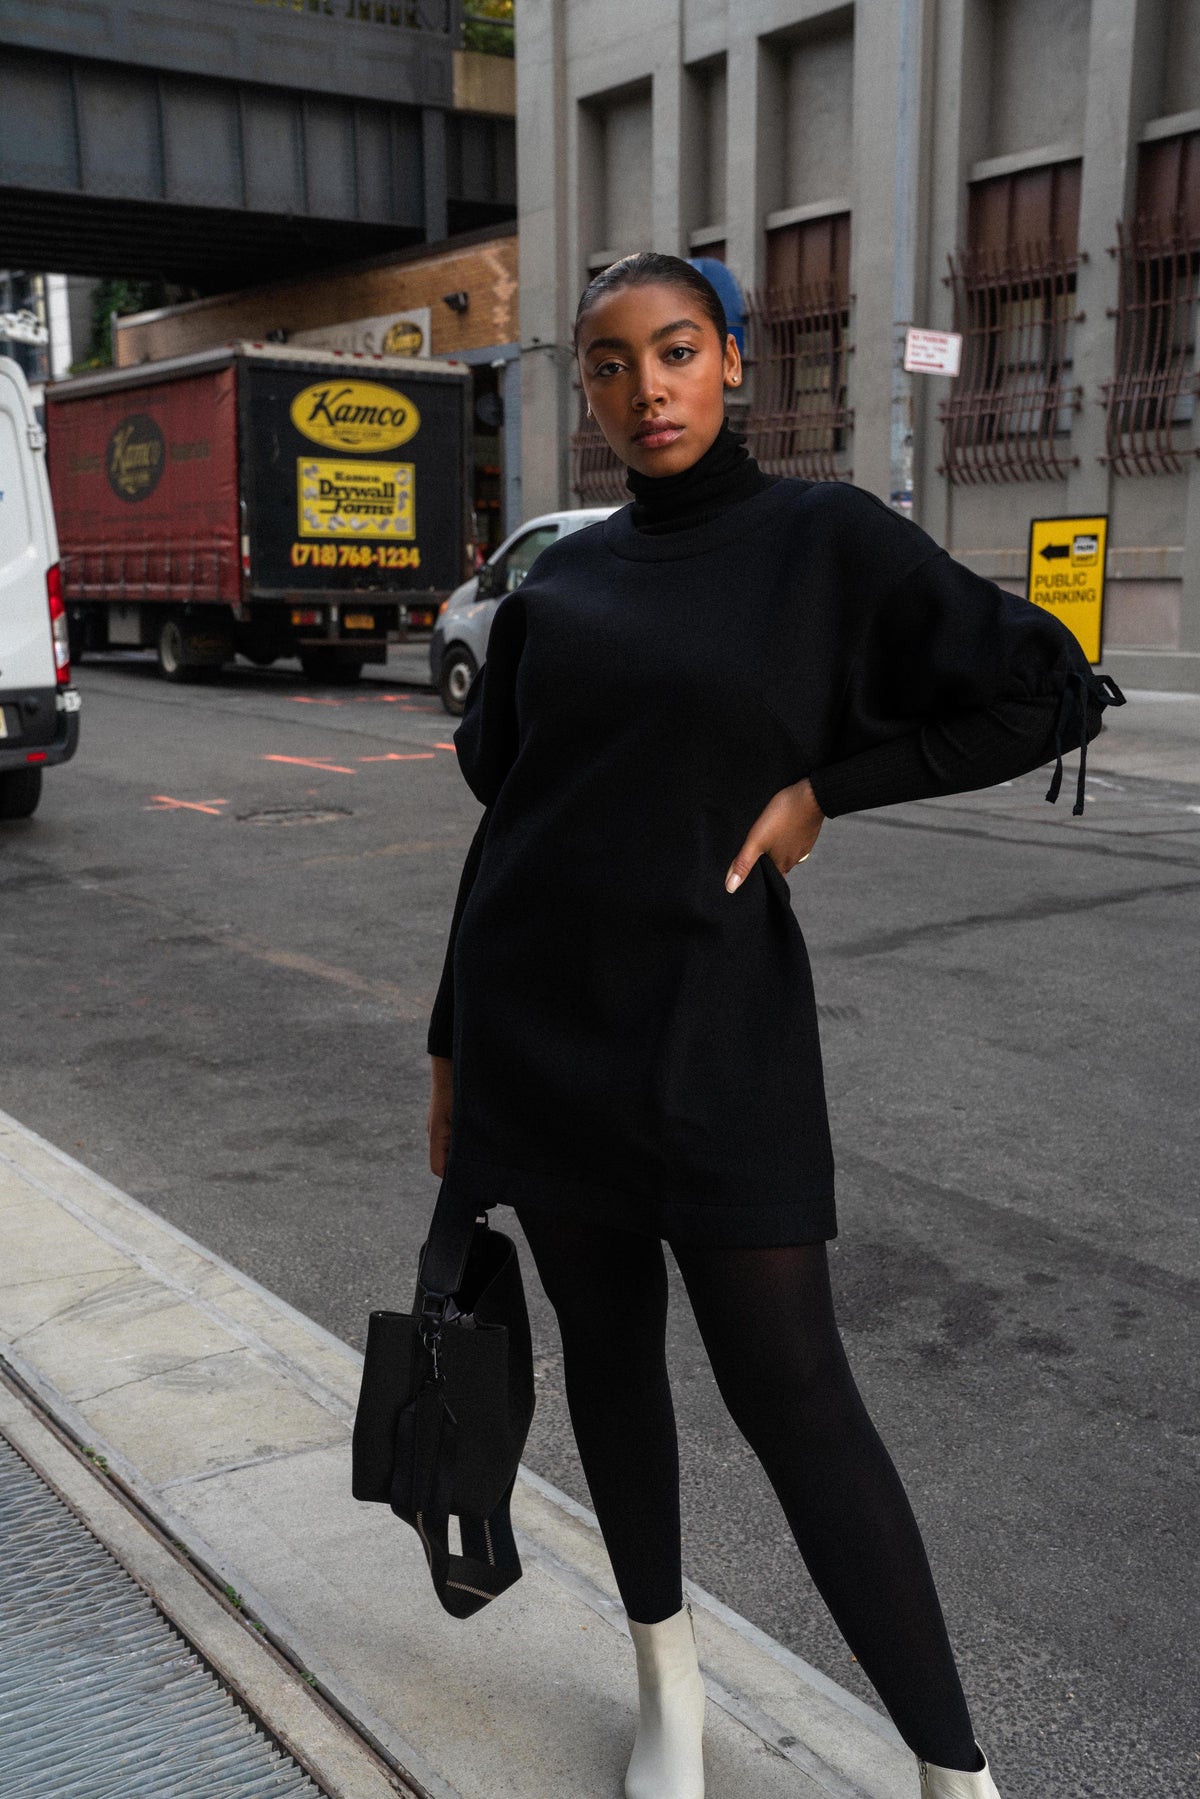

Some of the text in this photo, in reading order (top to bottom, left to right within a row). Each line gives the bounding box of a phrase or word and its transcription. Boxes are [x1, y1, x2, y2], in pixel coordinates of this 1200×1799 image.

[308, 388, 407, 427] Kamco
[319, 479, 395, 500] Drywall
[319, 499, 394, 515] Forms
[291, 542, 420, 569] (718) 768-1234
[1034, 572, 1088, 588] PUBLIC
[1034, 588, 1097, 605] PARKING
